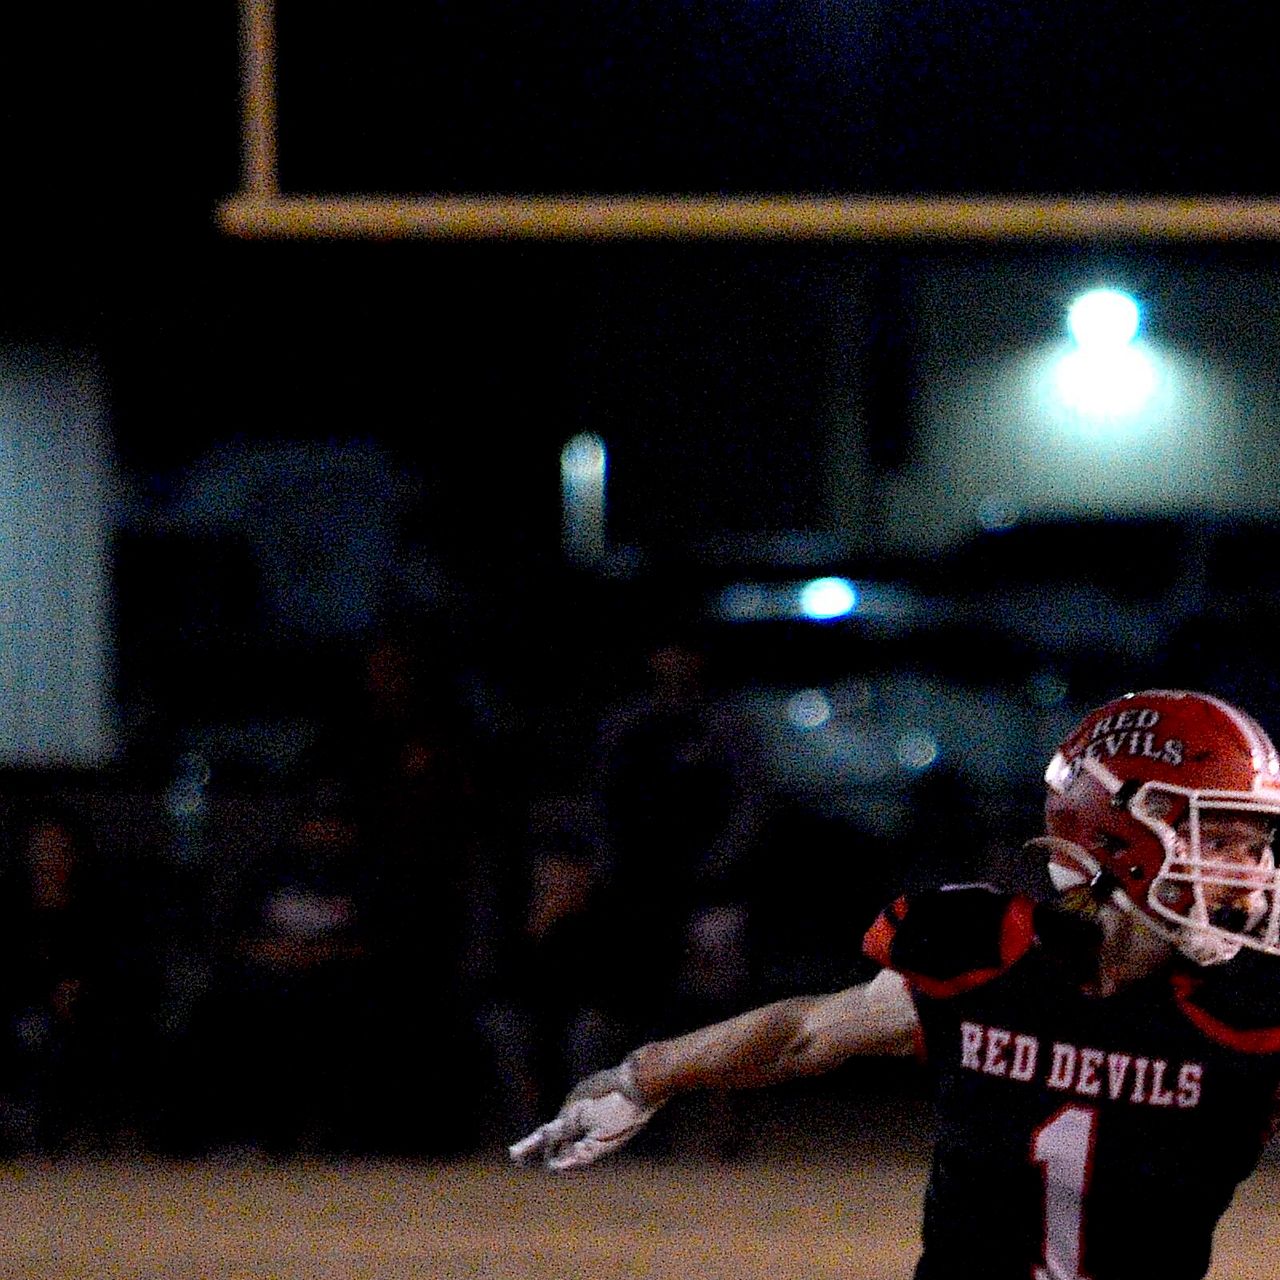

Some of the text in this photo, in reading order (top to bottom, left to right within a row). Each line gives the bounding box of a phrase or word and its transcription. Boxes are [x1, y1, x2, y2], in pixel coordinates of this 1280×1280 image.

[1091, 708, 1160, 739] RED
[960, 1020, 1203, 1108] RED DEVILS
